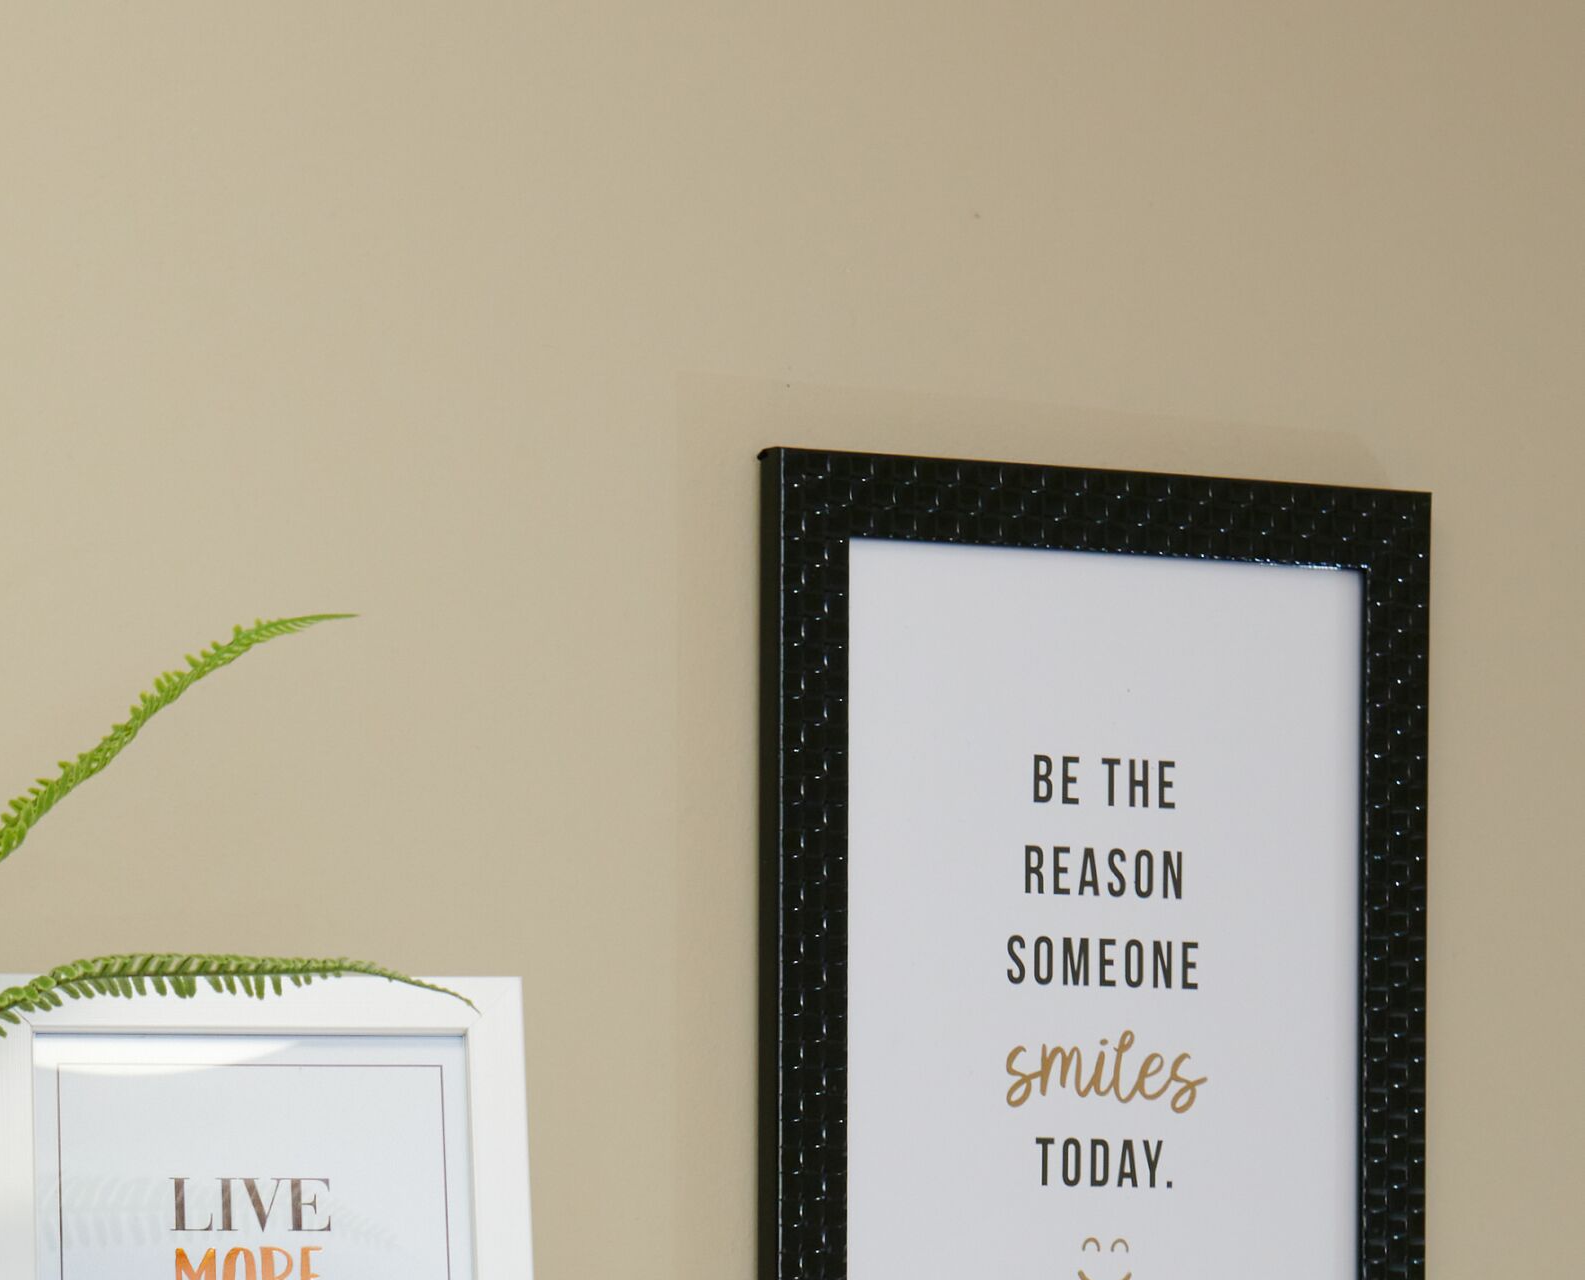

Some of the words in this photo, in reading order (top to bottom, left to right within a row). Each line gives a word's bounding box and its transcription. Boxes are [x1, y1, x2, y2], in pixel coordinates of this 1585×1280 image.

[1033, 753, 1080, 805] BE
[1101, 758, 1176, 809] THE
[1023, 844, 1184, 900] REASON
[1006, 935, 1200, 990] SOMEONE
[1005, 1029, 1209, 1114] smiles
[1035, 1137, 1174, 1189] TODAY.
[169, 1176, 332, 1233] LIVE
